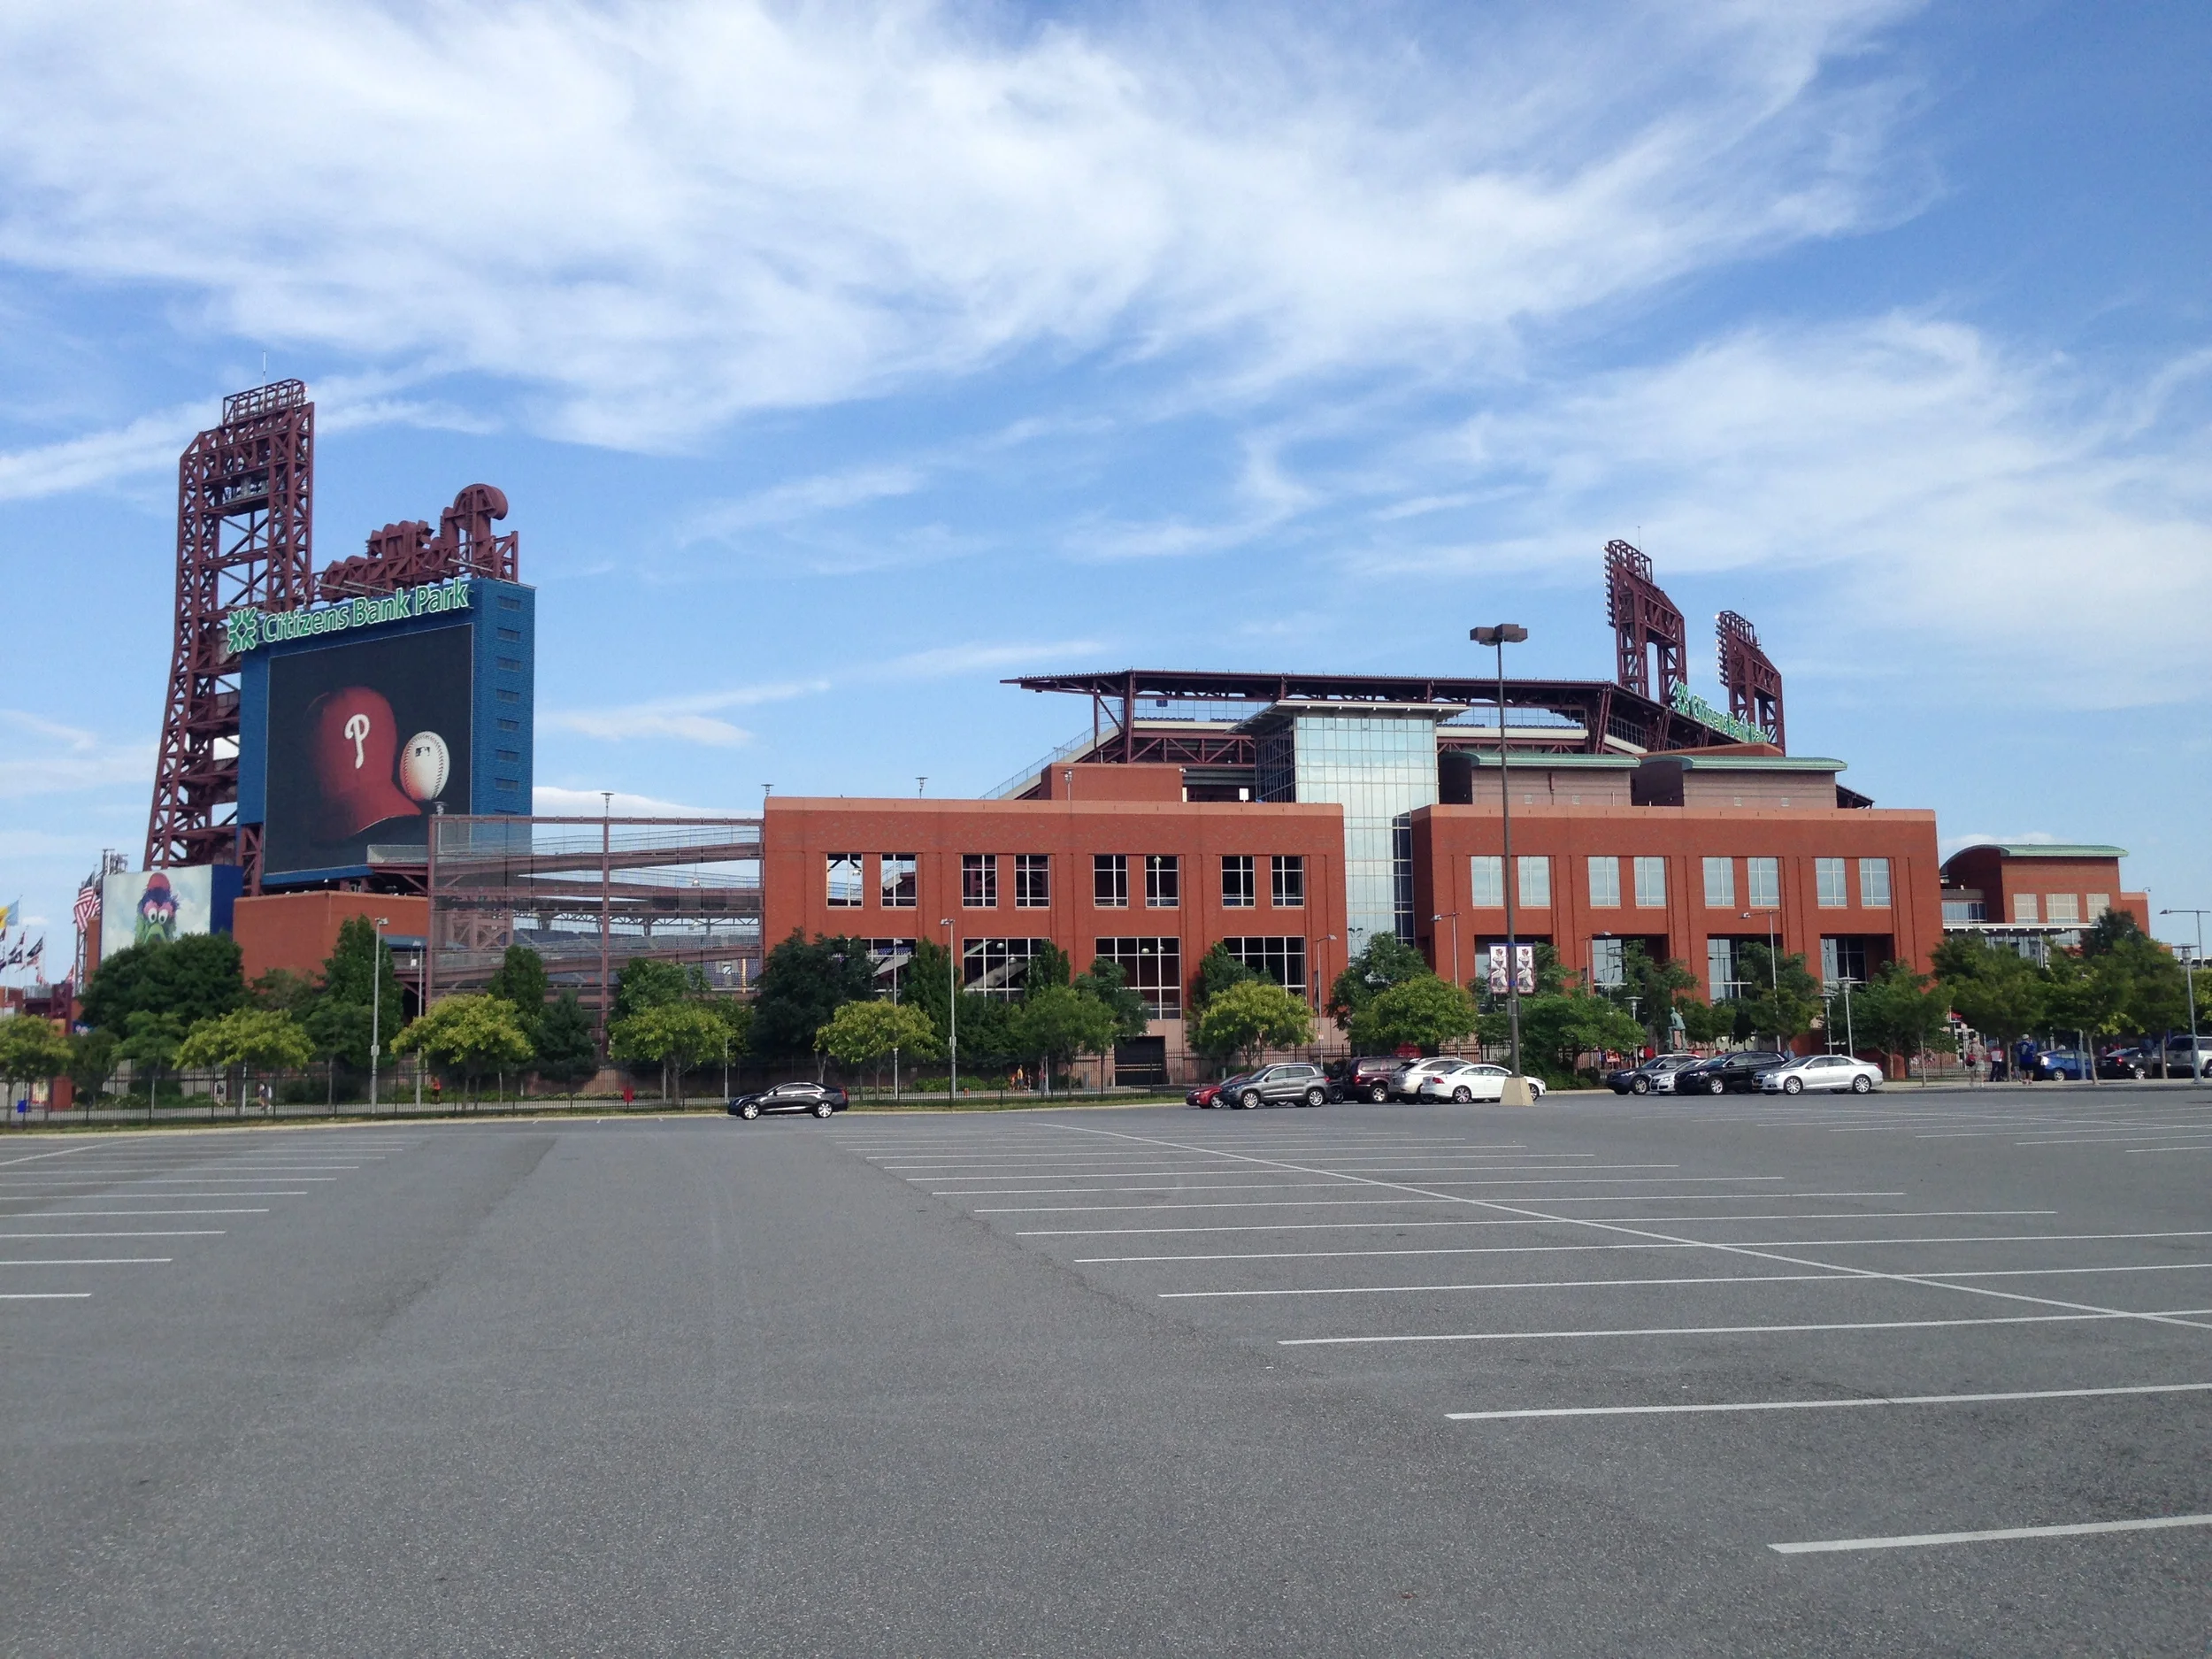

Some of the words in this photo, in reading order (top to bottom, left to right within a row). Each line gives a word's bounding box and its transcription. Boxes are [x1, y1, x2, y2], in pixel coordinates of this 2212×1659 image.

[263, 605, 349, 643] Citizens
[352, 587, 411, 627] Bank
[415, 577, 469, 615] Park
[344, 713, 371, 769] P
